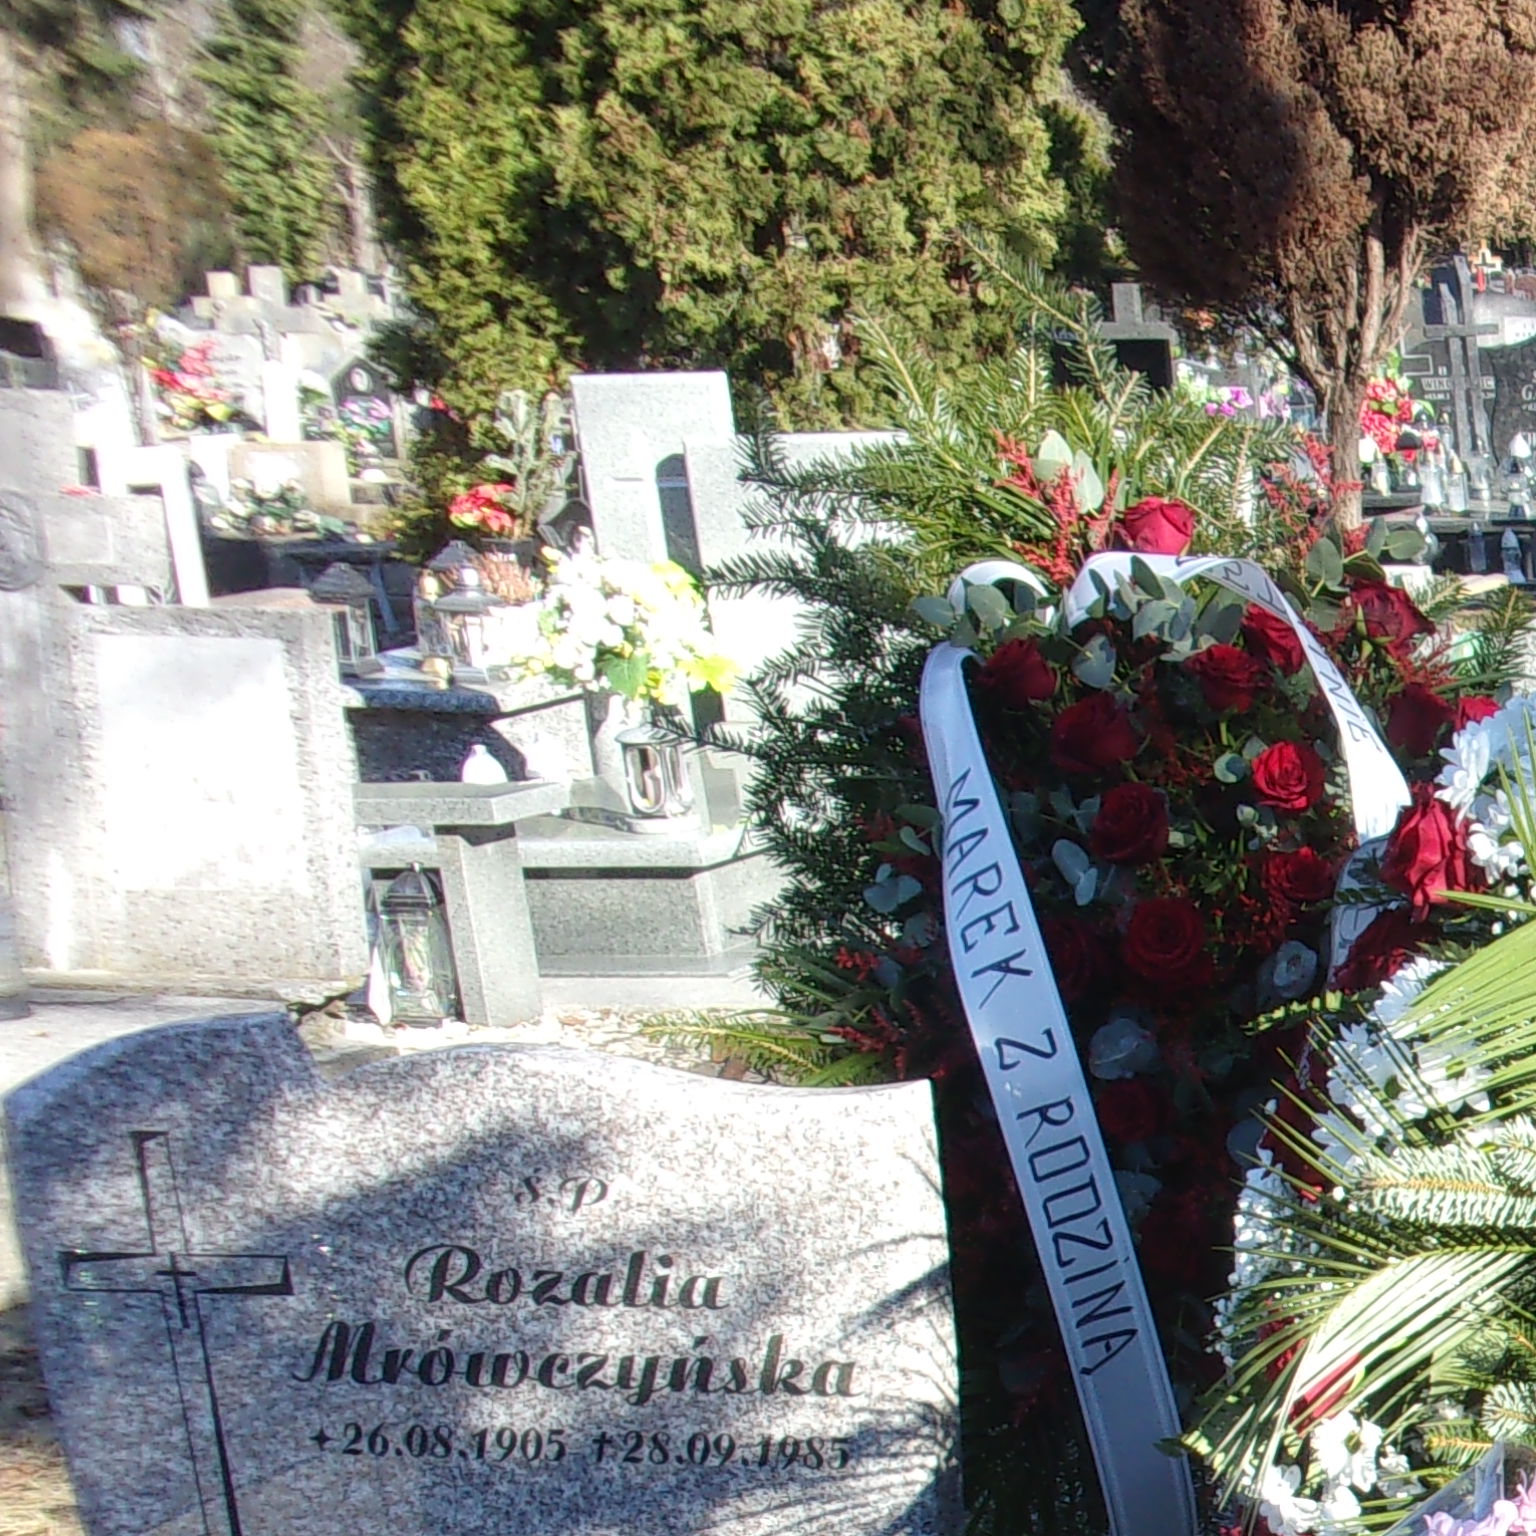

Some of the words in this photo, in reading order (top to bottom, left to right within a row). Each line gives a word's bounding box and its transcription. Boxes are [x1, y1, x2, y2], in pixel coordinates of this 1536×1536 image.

[942, 767, 1033, 1009] MAREK
[998, 1027, 1059, 1072] Z
[404, 1243, 732, 1312] Rozalia
[291, 1318, 867, 1404] Mrówczyńska
[343, 1423, 567, 1463] 26.08.1905
